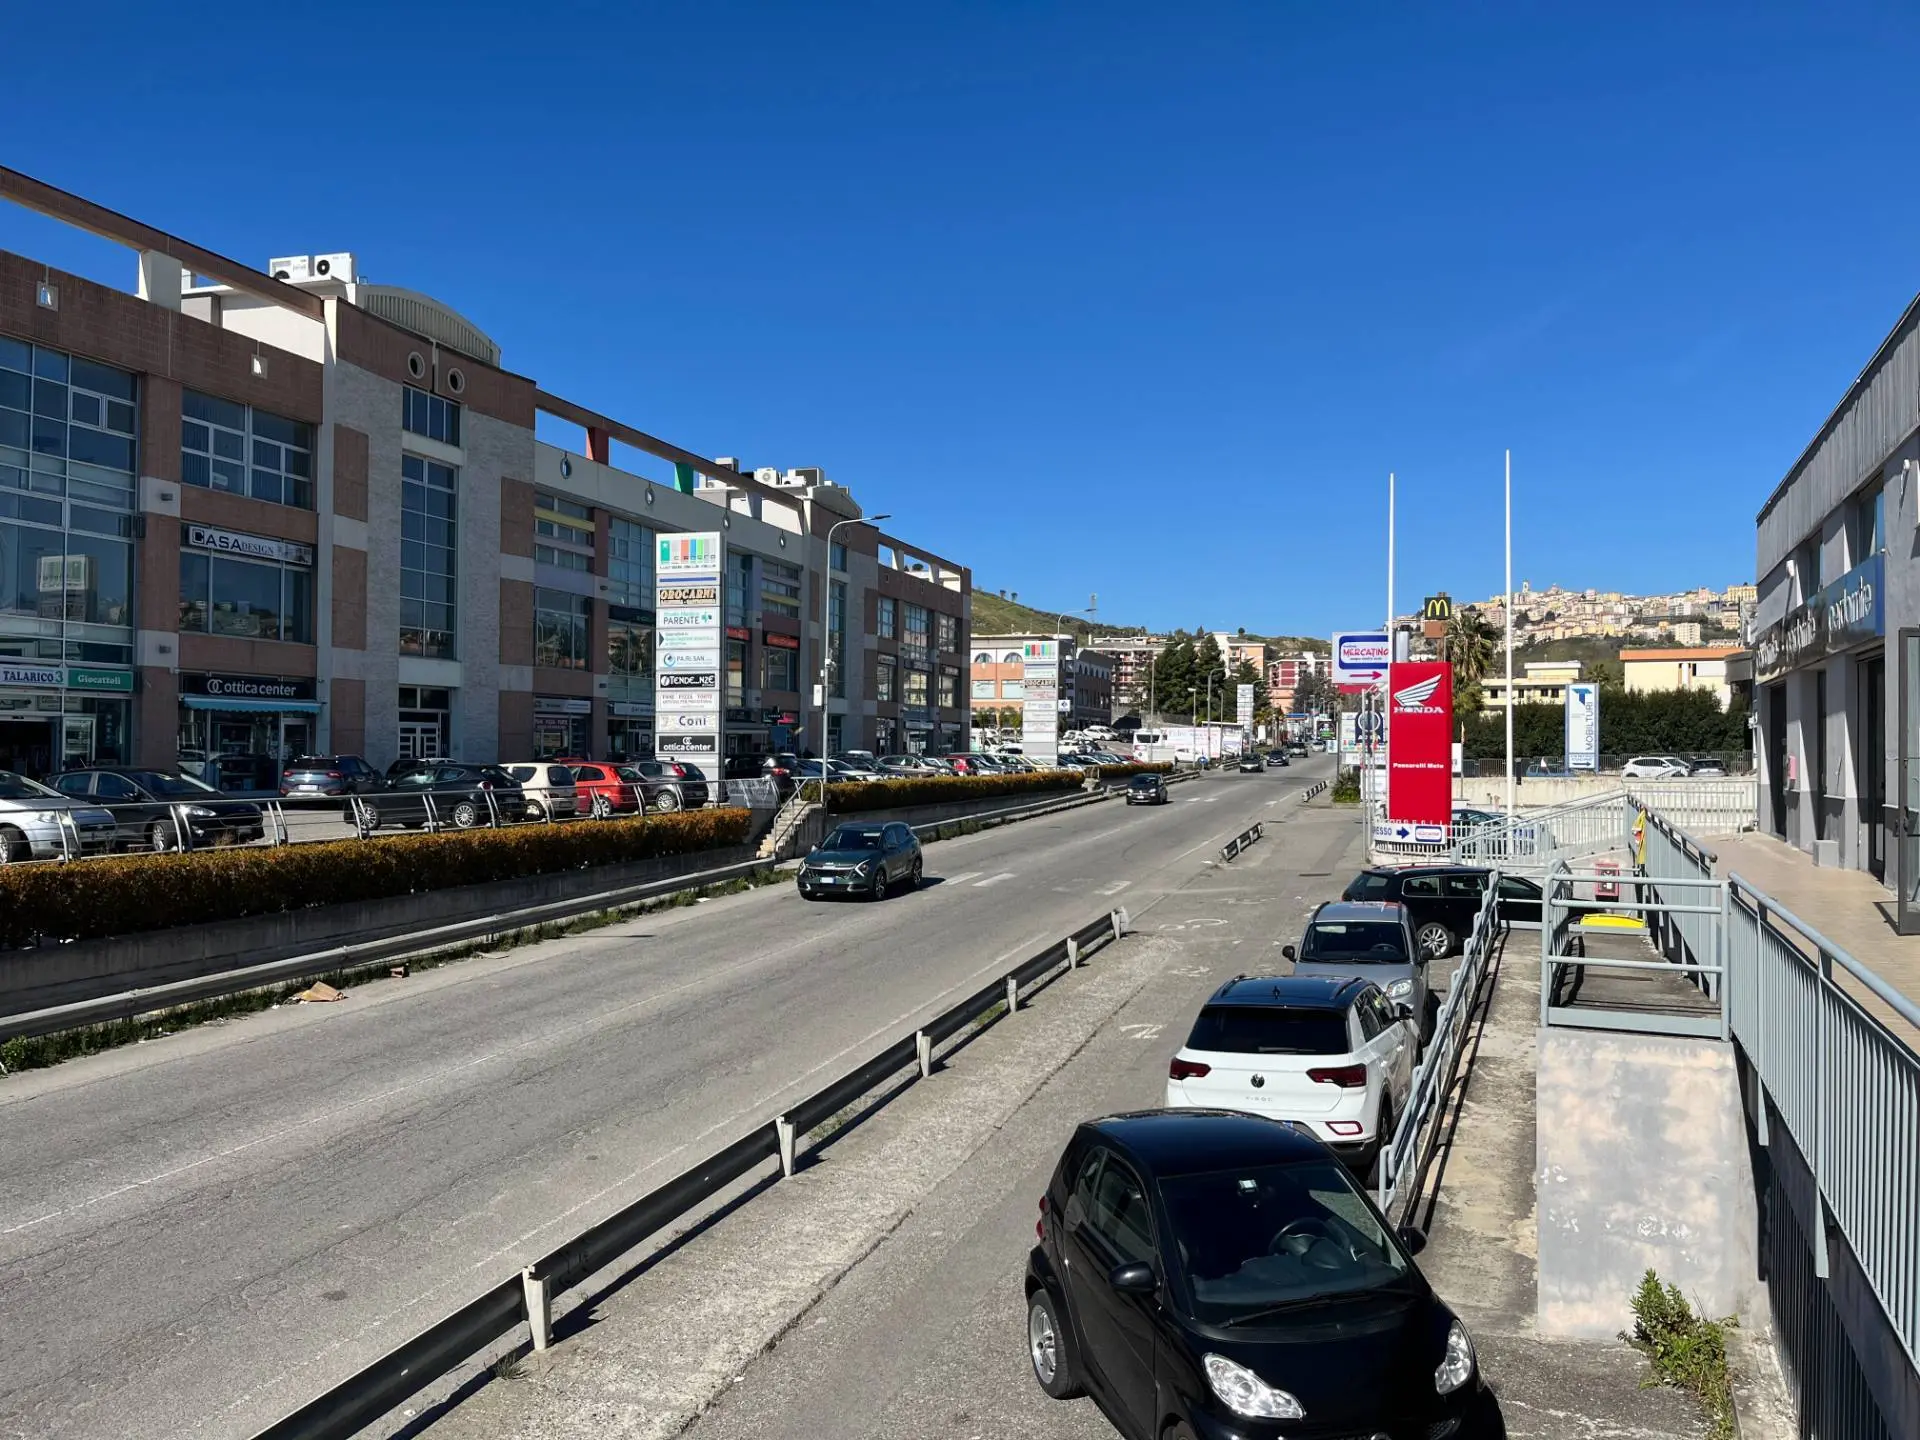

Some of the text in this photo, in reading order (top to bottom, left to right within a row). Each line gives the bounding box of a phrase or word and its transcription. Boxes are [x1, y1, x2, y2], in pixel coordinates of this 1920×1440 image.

[192, 528, 274, 556] CASA DESIGN
[663, 616, 700, 625] PARENTE
[3, 671, 54, 682] TALARICO
[78, 675, 121, 685] Giocattoli
[1393, 706, 1444, 714] HONDA
[1585, 701, 1594, 751] MOBILTURI
